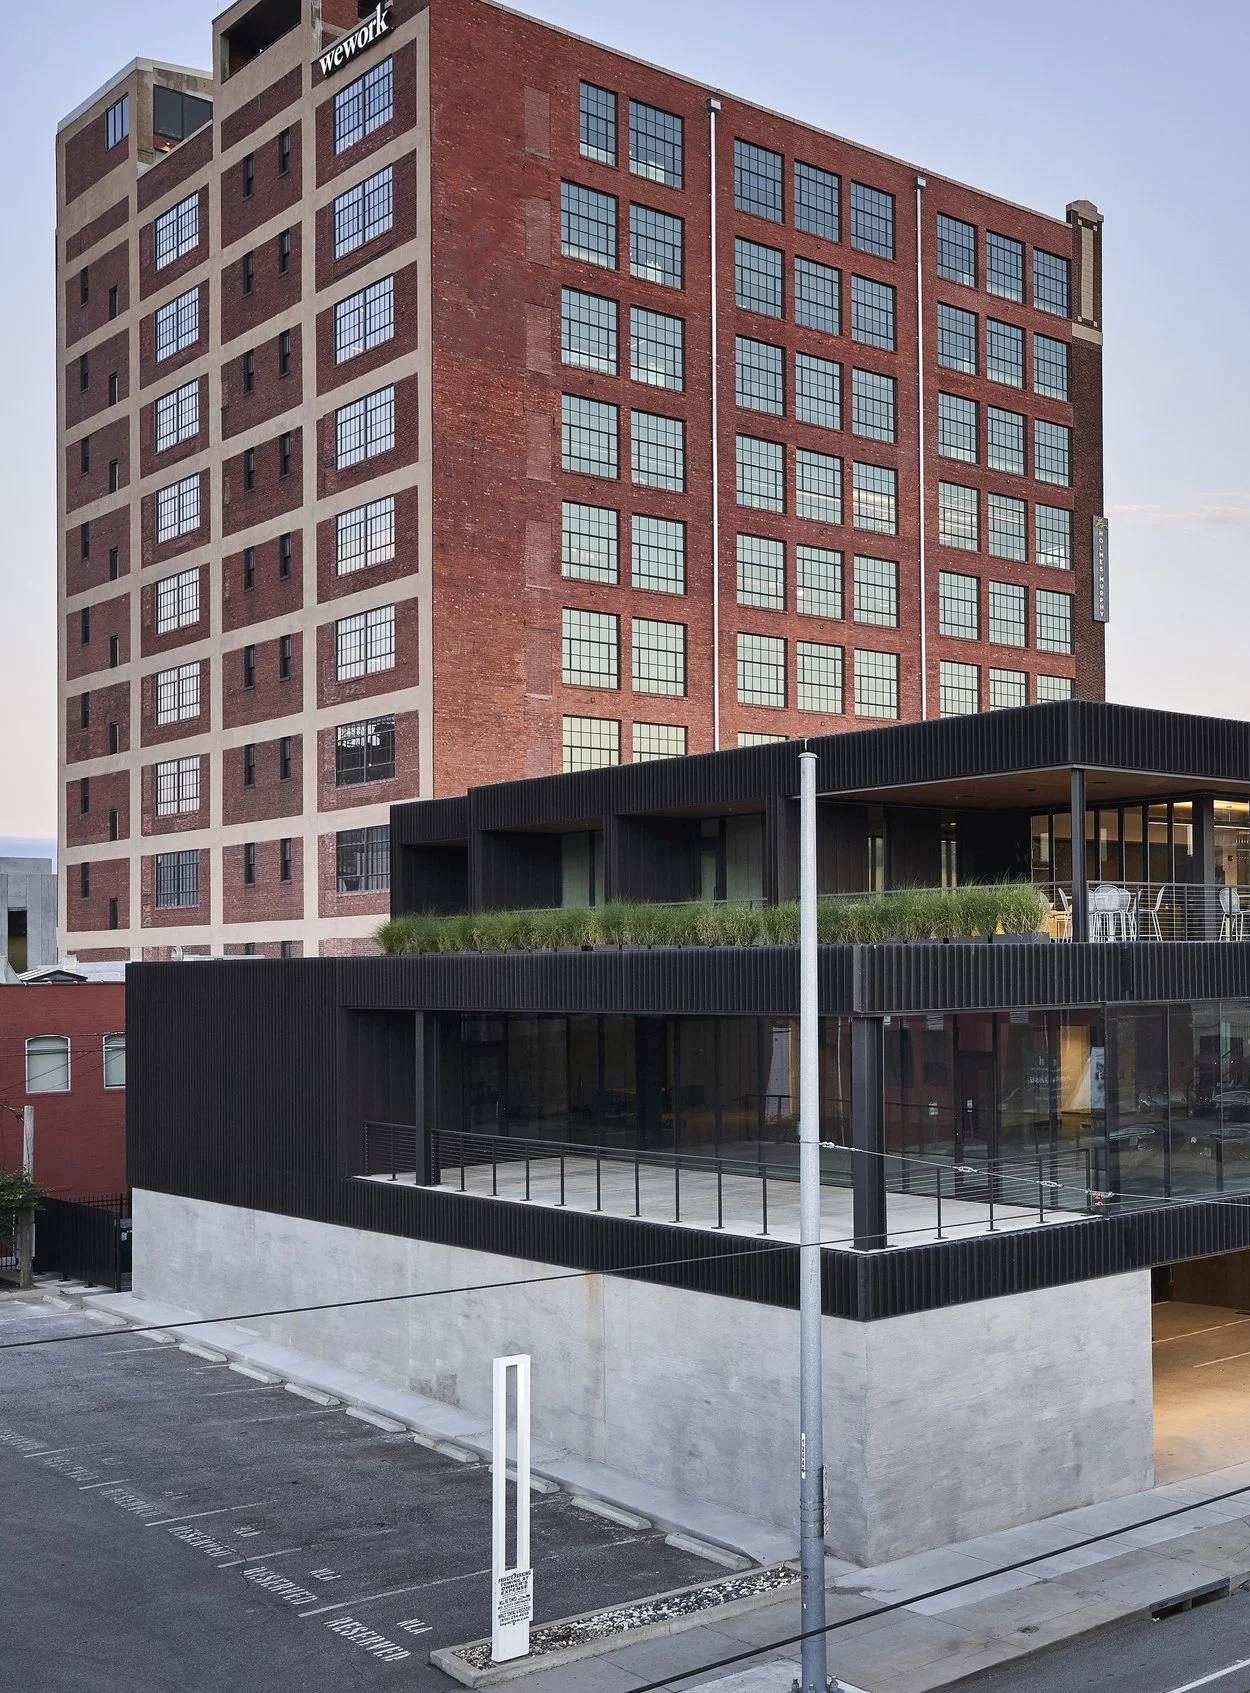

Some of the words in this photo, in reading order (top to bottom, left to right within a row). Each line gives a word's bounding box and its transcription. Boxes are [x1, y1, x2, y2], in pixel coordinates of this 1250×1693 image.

[319, 2, 389, 75] wework
[167, 1523, 238, 1558] RESERVED
[242, 1565, 319, 1606] RESERVED
[500, 1580, 528, 1591] OWNER'S
[500, 1584, 528, 1596] EXPENSE
[513, 1570, 531, 1578] PARKING
[323, 1615, 412, 1663] RESERVED
